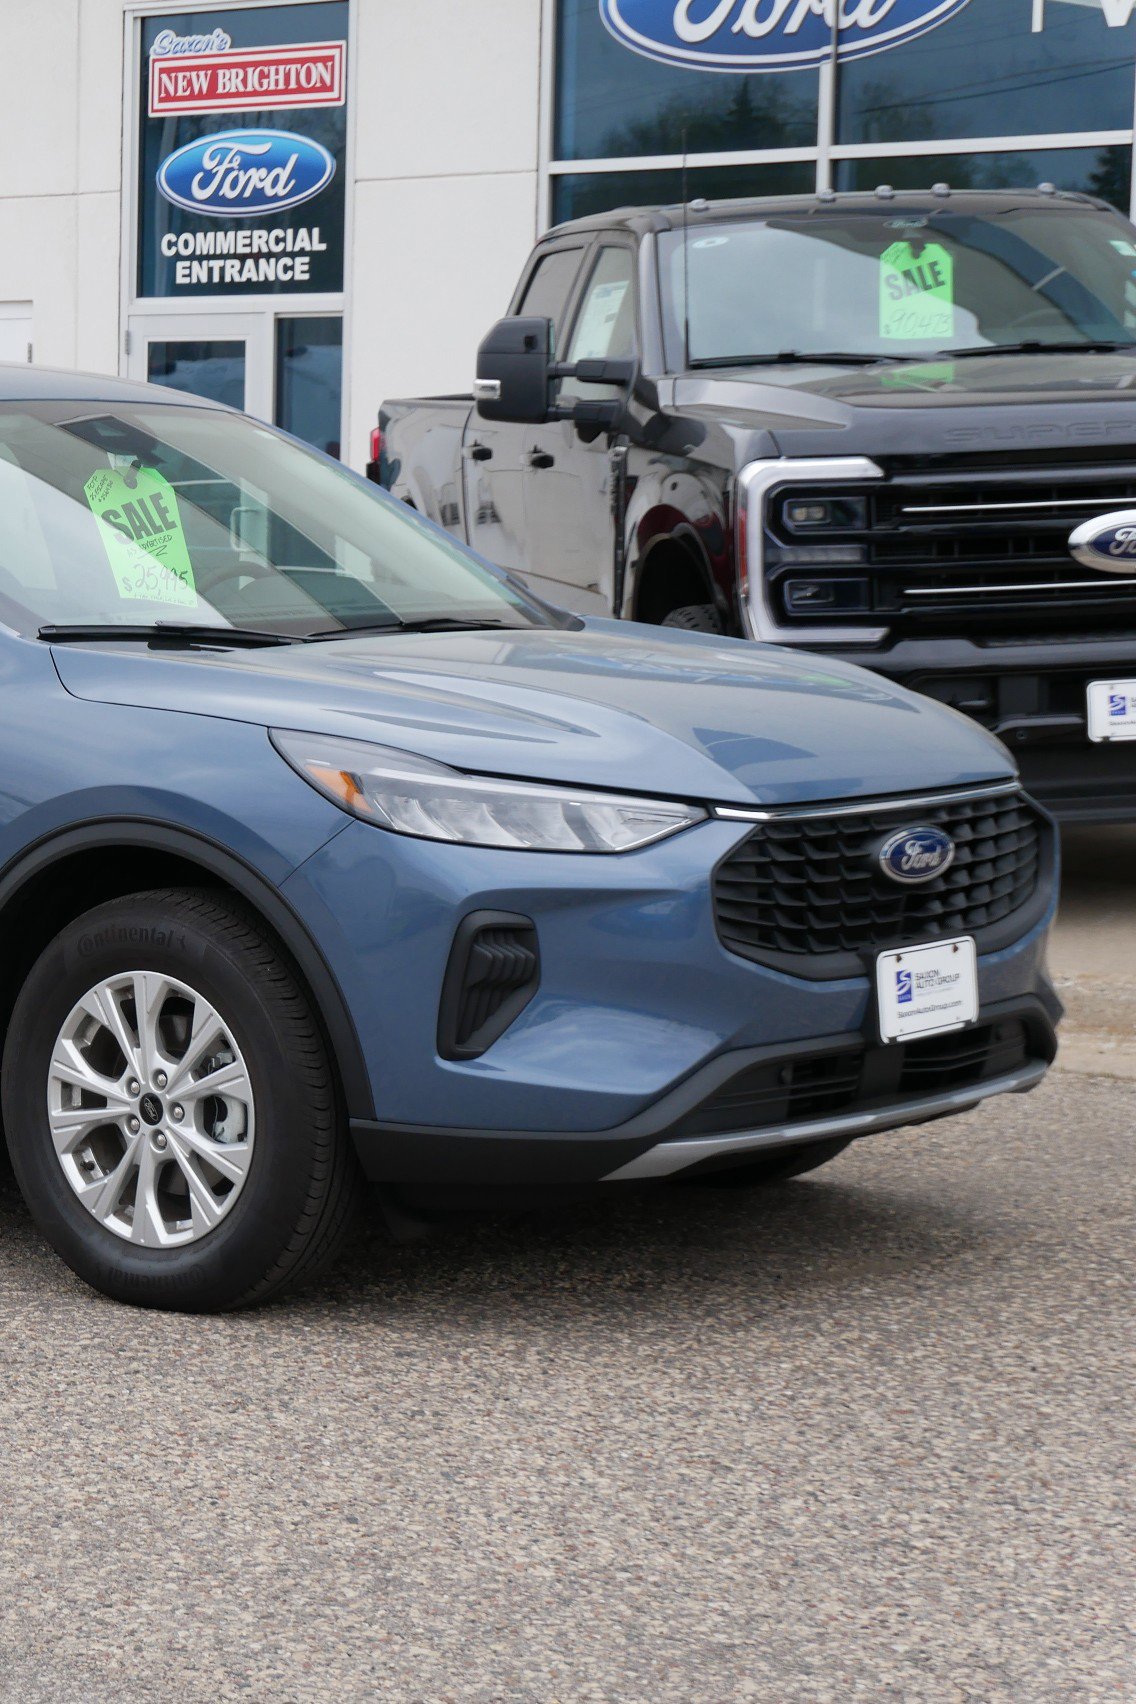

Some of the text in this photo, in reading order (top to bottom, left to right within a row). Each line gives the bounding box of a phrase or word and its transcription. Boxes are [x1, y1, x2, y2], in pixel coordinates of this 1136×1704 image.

[152, 29, 229, 55] Saxon's
[160, 62, 333, 98] NEW BRIGHTON
[191, 142, 299, 200] Ford
[161, 227, 327, 257] COMMERCIAL
[175, 257, 310, 285] ENTRANCE
[884, 260, 946, 301] SALE
[101, 492, 178, 544] SALE
[901, 840, 942, 870] Ford
[78, 925, 174, 957] Continental
